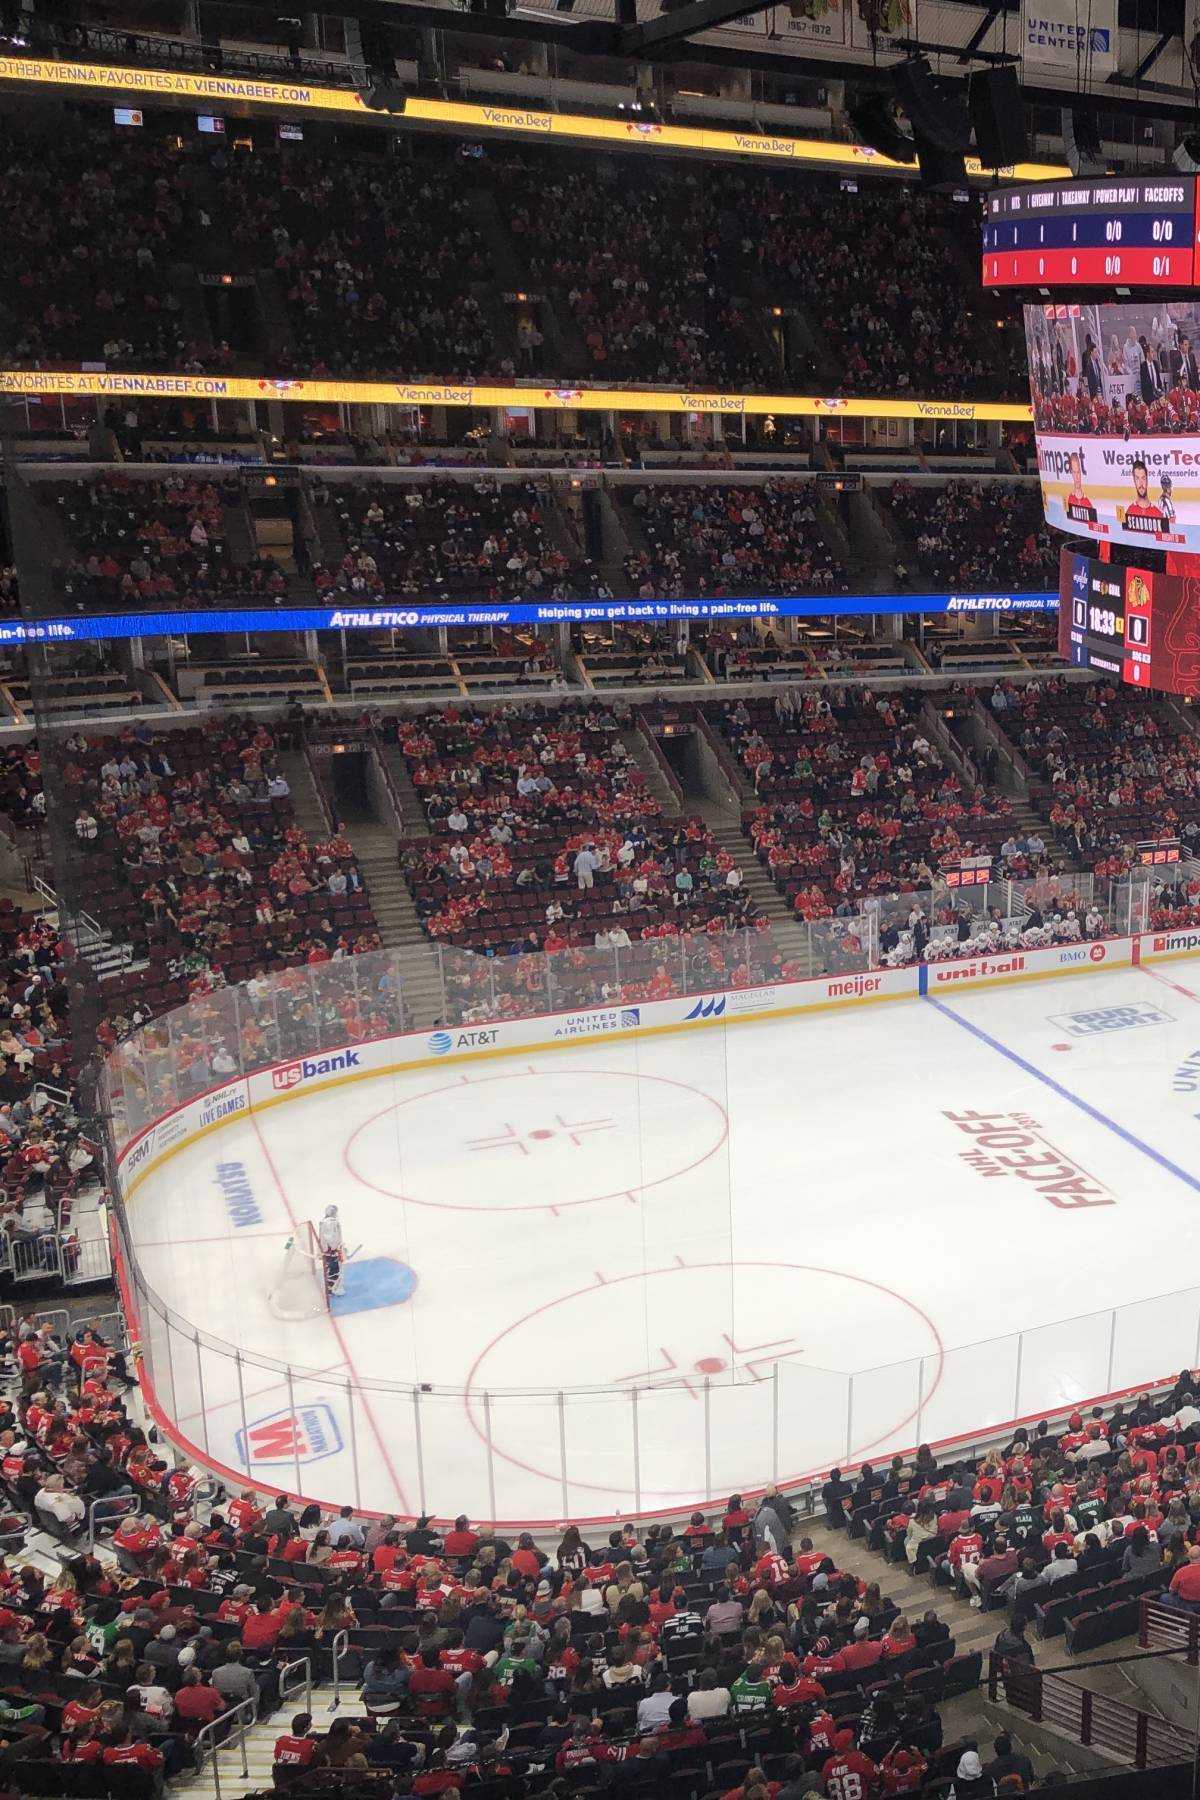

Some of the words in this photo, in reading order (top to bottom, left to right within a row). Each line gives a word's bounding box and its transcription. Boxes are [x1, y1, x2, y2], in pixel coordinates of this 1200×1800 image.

[1029, 19, 1086, 36] UNITED
[1028, 32, 1085, 51] CENTER
[0, 61, 42, 78] OTHER
[46, 66, 97, 83] VIENNA
[100, 70, 172, 90] FAVORITES
[175, 78, 192, 91] AT
[195, 81, 312, 103] VIENNABEEF.COM
[1106, 221, 1122, 242] 0/0
[1152, 220, 1173, 242] 0/0
[0, 376, 74, 391] FAVORITES
[79, 377, 95, 390] AT
[99, 376, 228, 395] VIENNABEEF.COM
[538, 607, 582, 620] Helping
[584, 607, 605, 618] you
[607, 606, 626, 618] get
[628, 604, 654, 616] back
[656, 605, 668, 615] to
[670, 604, 700, 616] living
[702, 606, 708, 614] a
[710, 602, 759, 615] pain-free
[759, 602, 780, 613] life.
[946, 598, 1012, 610] ATHLETICO
[1012, 599, 1045, 608] PHYSICAL
[330, 611, 419, 627] ATHLETICO
[420, 613, 466, 624] PHYSICAL
[467, 612, 510, 623] THERAPY
[1059, 949, 1087, 964] BMO
[936, 957, 1025, 982] uni-ball
[828, 975, 882, 1000] meijer
[566, 1012, 617, 1027] UNITED
[1067, 1011, 1164, 1034] LIGHT
[1070, 1006, 1140, 1025] BUD
[457, 1028, 499, 1051] AT&T
[554, 1021, 617, 1037] AIRLINES
[273, 1065, 302, 1089] us
[303, 1050, 361, 1078] bank
[199, 1106, 216, 1128] LIVE
[216, 1094, 246, 1119] GAMES
[127, 1140, 150, 1173] SRM
[940, 1109, 1117, 1210] FACE-OFF
[958, 1148, 1009, 1178] NHL
[213, 1161, 264, 1229] KOMATSU
[771, 1561, 790, 1583] 19
[279, 1748, 302, 1762] TOEWS
[831, 1764, 850, 1776] KANE
